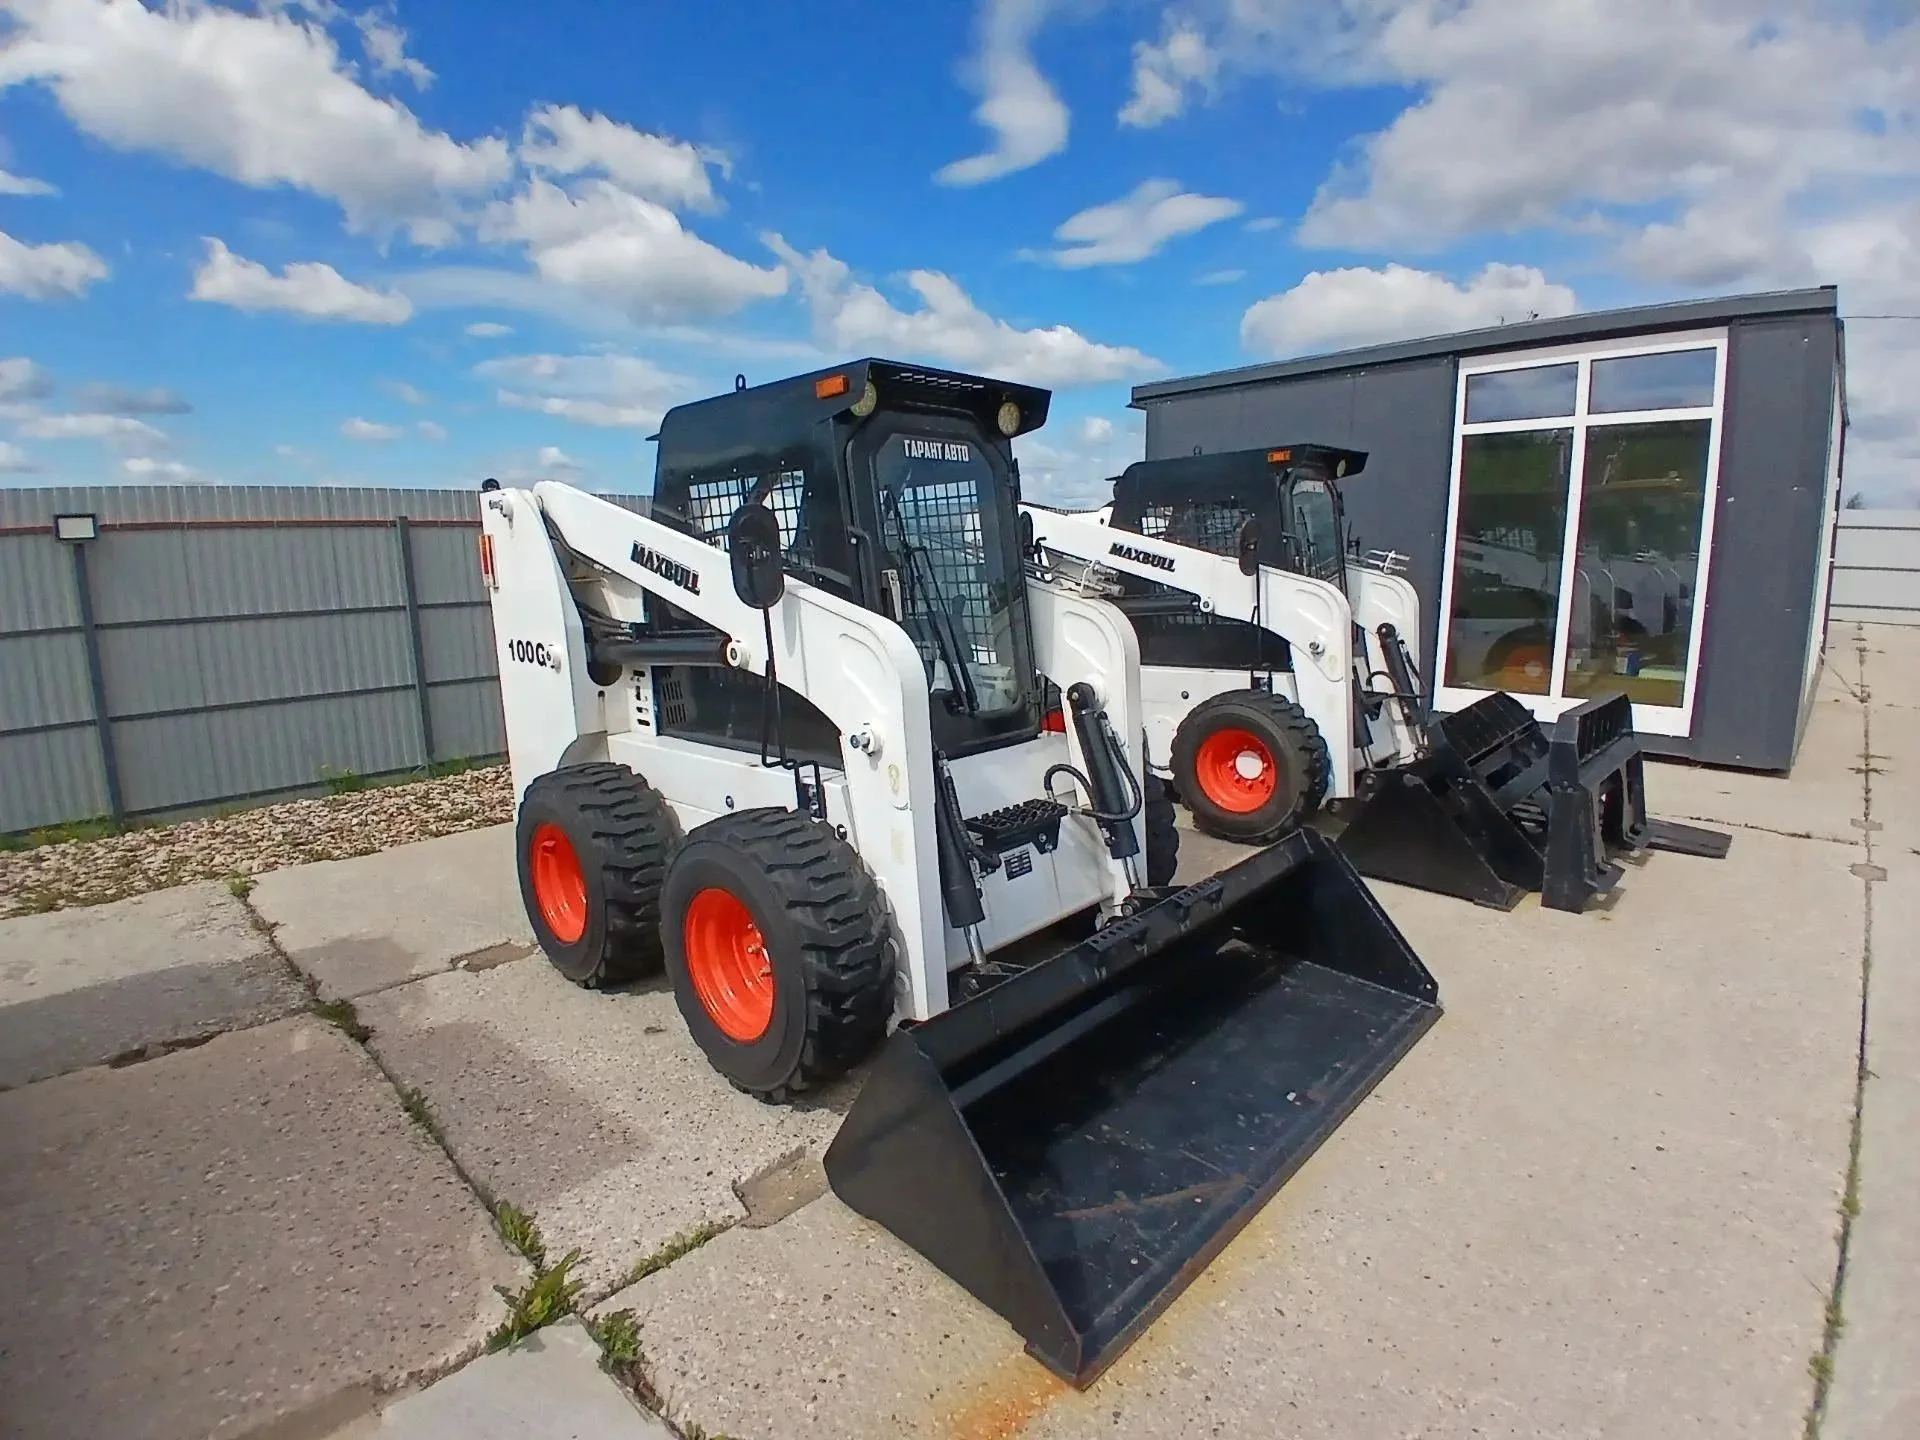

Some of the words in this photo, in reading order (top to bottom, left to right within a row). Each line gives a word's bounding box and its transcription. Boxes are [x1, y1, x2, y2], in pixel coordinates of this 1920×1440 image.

[904, 440, 942, 459] ГАРАНТ
[944, 443, 969, 461] АВТО
[630, 540, 700, 596] MAXBULL
[1108, 542, 1175, 572] MAXBULL
